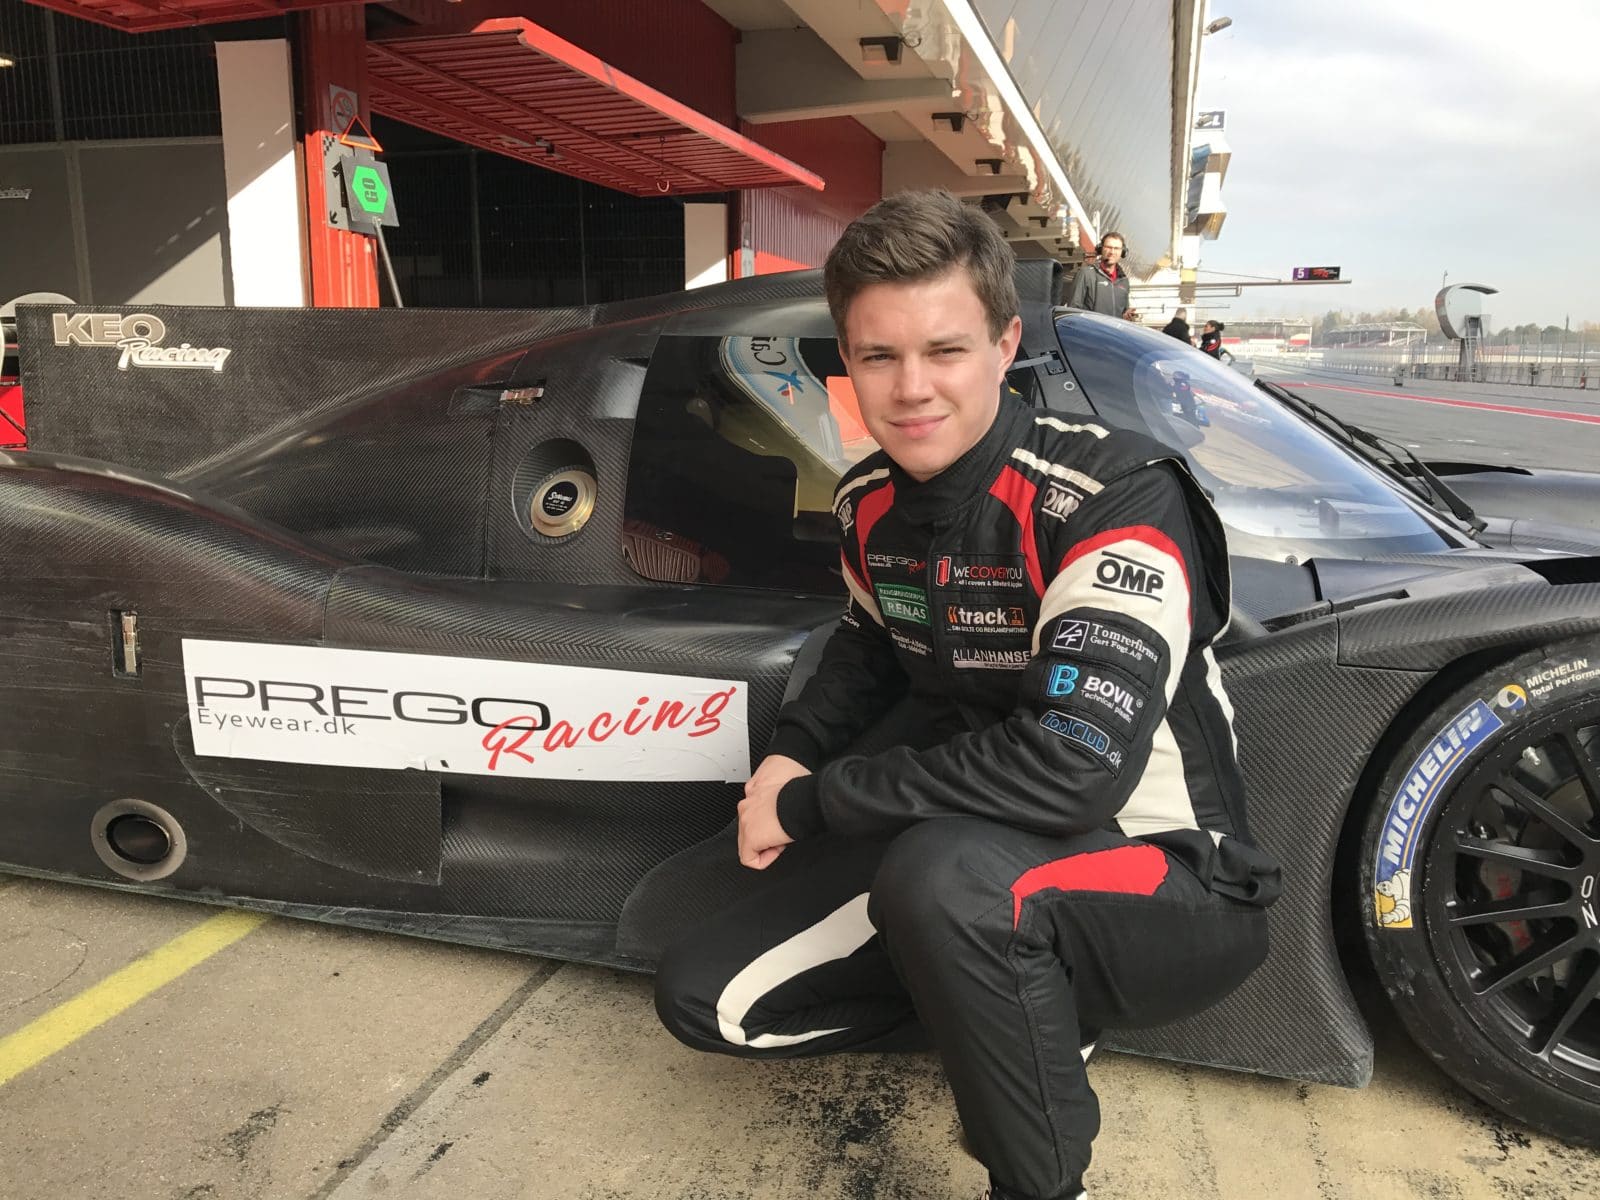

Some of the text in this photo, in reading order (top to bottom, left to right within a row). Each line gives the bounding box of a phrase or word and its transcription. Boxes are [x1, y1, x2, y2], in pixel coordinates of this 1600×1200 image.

[362, 177, 379, 202] GO
[1297, 269, 1304, 278] 5
[52, 313, 166, 346] KEO
[117, 338, 231, 371] Racing
[1044, 487, 1079, 517] OMP
[867, 554, 917, 567] PREGO
[1097, 559, 1164, 593] OMP
[887, 602, 926, 620] RENAS
[958, 607, 1008, 626] track
[1047, 664, 1079, 697] B
[1526, 658, 1588, 689] MICHELIN
[194, 676, 551, 732] PREGO
[1081, 689, 1114, 709] Technical
[1530, 682, 1554, 698] Total
[198, 707, 356, 737] Eyewear.dk
[482, 685, 737, 771] Racing
[1382, 706, 1483, 867] MICHELIN
